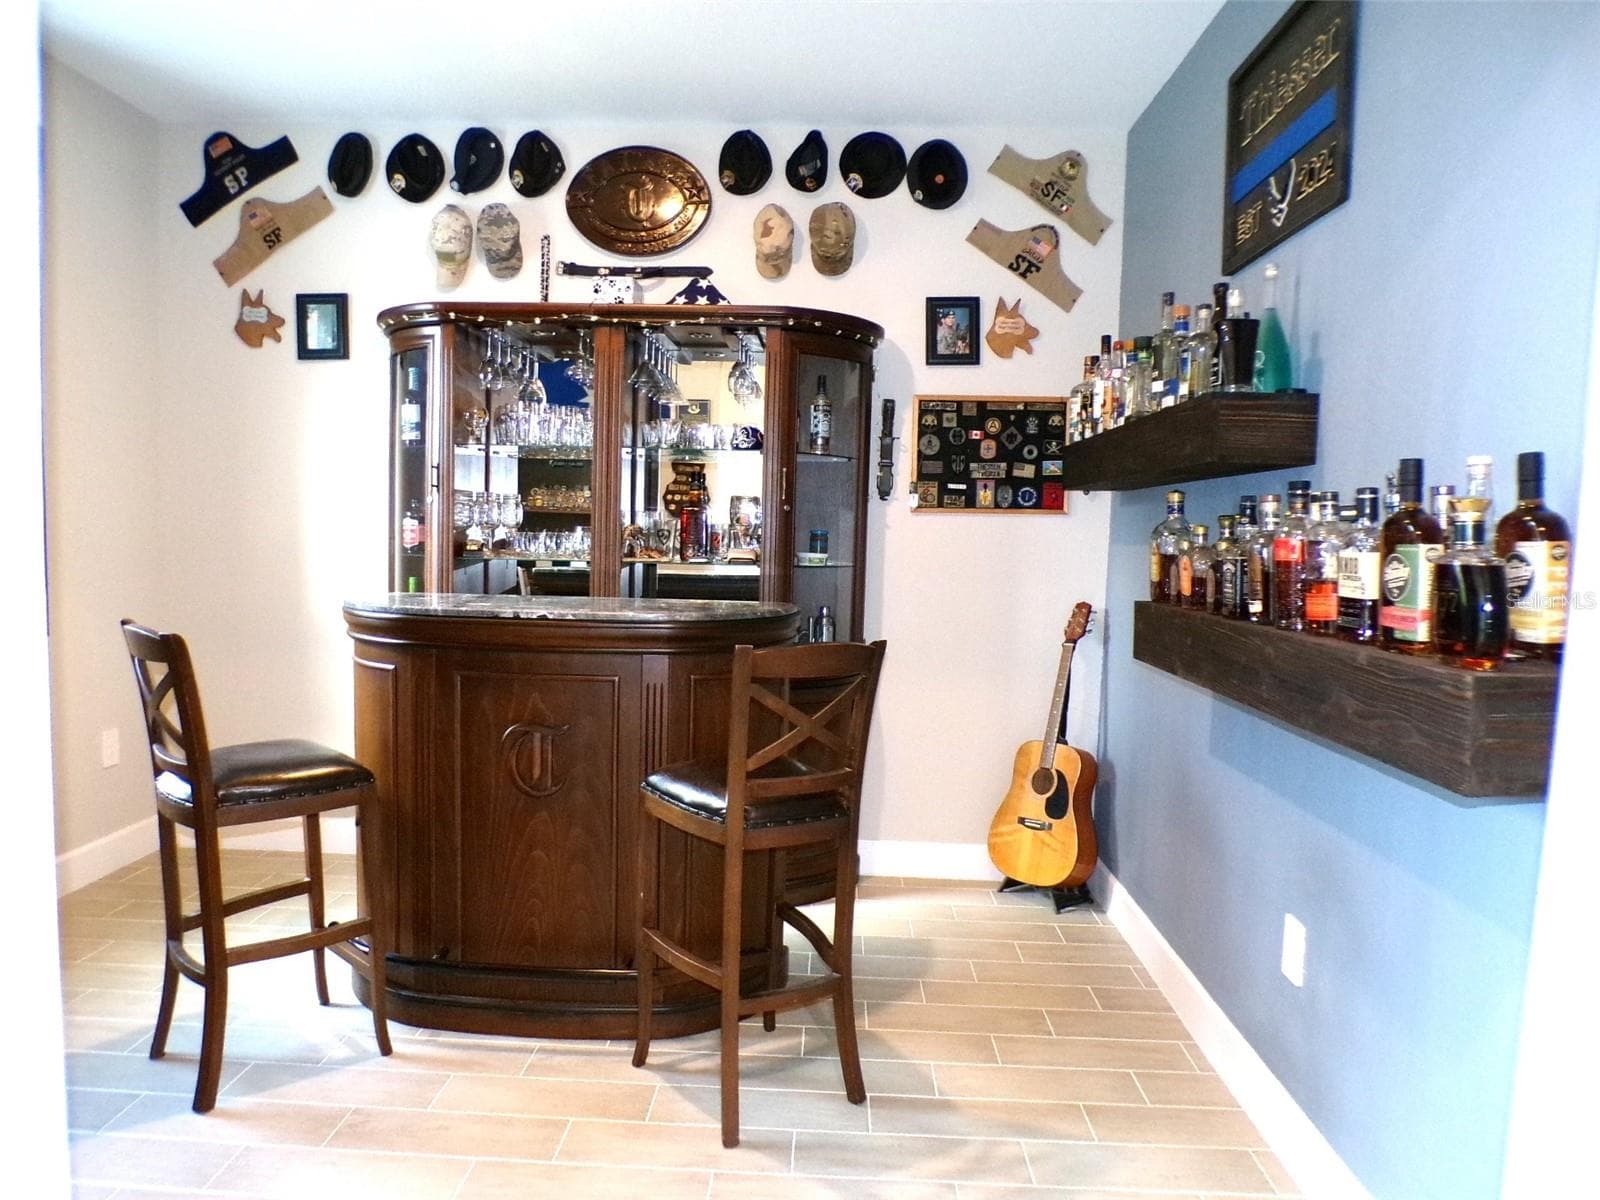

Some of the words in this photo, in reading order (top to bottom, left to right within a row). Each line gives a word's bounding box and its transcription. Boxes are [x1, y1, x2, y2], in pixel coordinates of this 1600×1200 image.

[224, 166, 248, 194] SP
[1041, 181, 1066, 201] SF
[263, 227, 282, 250] SF
[1008, 254, 1042, 279] SF
